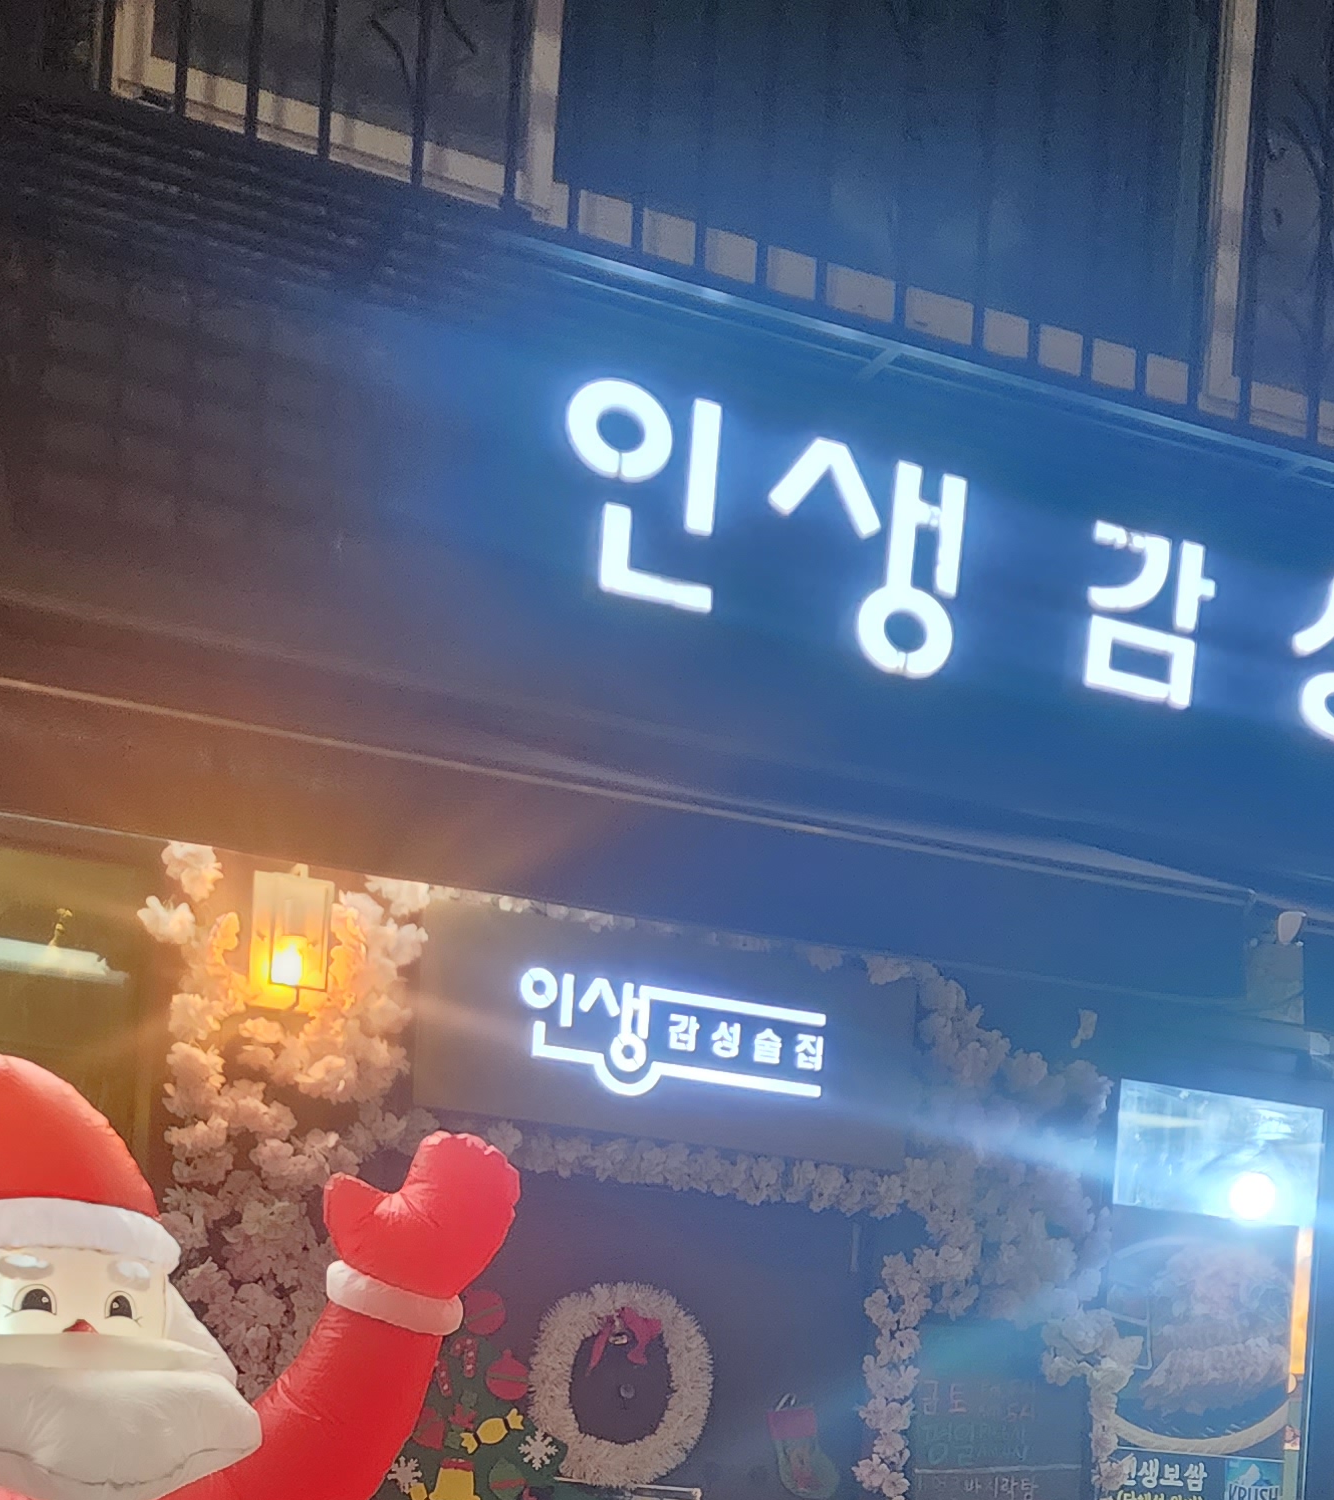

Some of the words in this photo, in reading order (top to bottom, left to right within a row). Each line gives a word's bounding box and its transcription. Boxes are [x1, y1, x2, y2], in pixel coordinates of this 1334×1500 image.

[565, 377, 968, 680] 인생
[520, 967, 650, 1072] 인생
[668, 1013, 825, 1072] 감성술집
